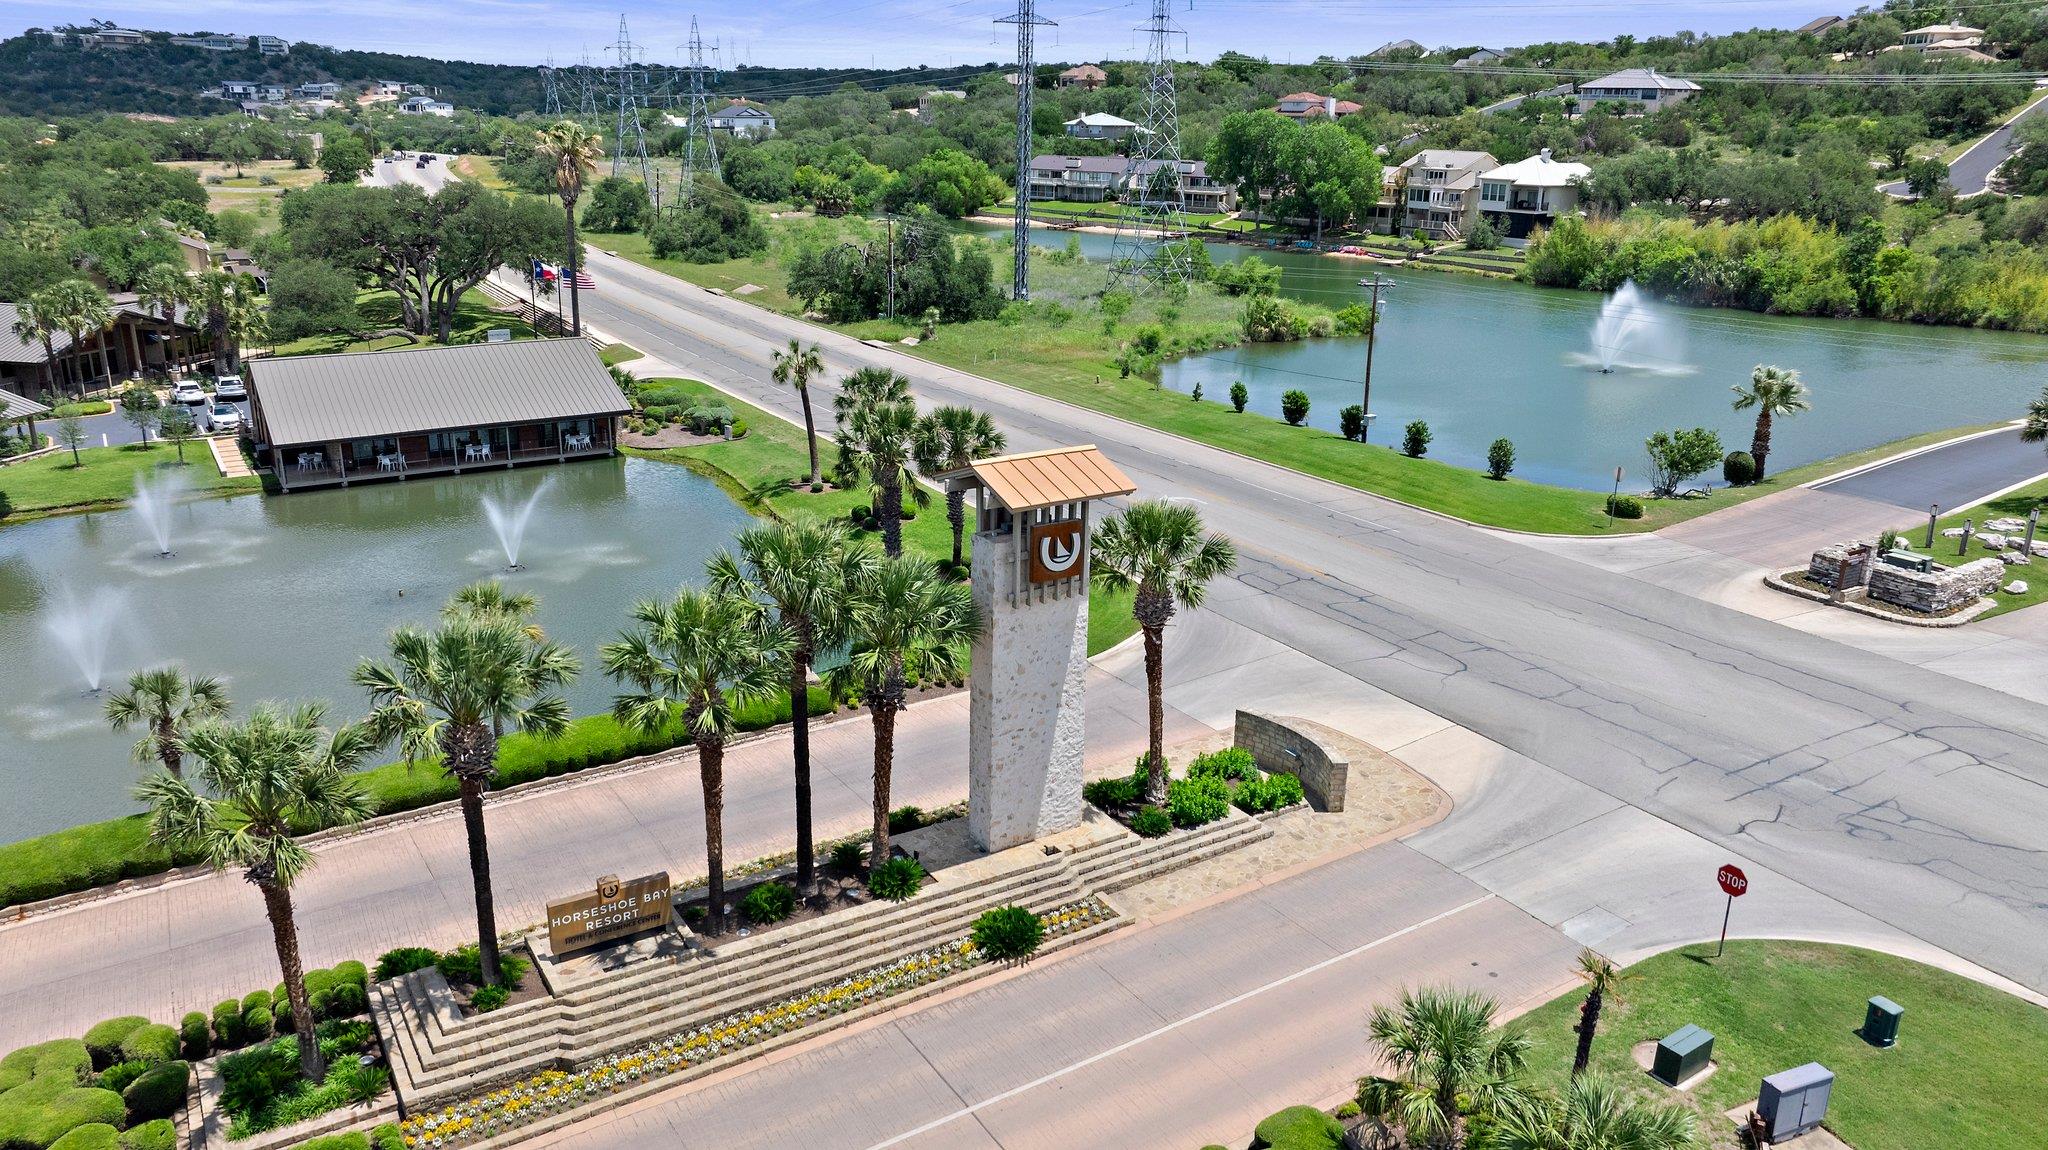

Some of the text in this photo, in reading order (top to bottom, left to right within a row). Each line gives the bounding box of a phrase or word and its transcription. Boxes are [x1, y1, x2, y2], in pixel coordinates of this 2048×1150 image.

[1719, 871, 1746, 890] STOP
[552, 888, 669, 928] HORSESHOE BAY
[586, 908, 640, 931] RESORT
[565, 933, 587, 945] HOTEL
[594, 920, 637, 936] CONFERENCE
[637, 912, 661, 925] CENTER
